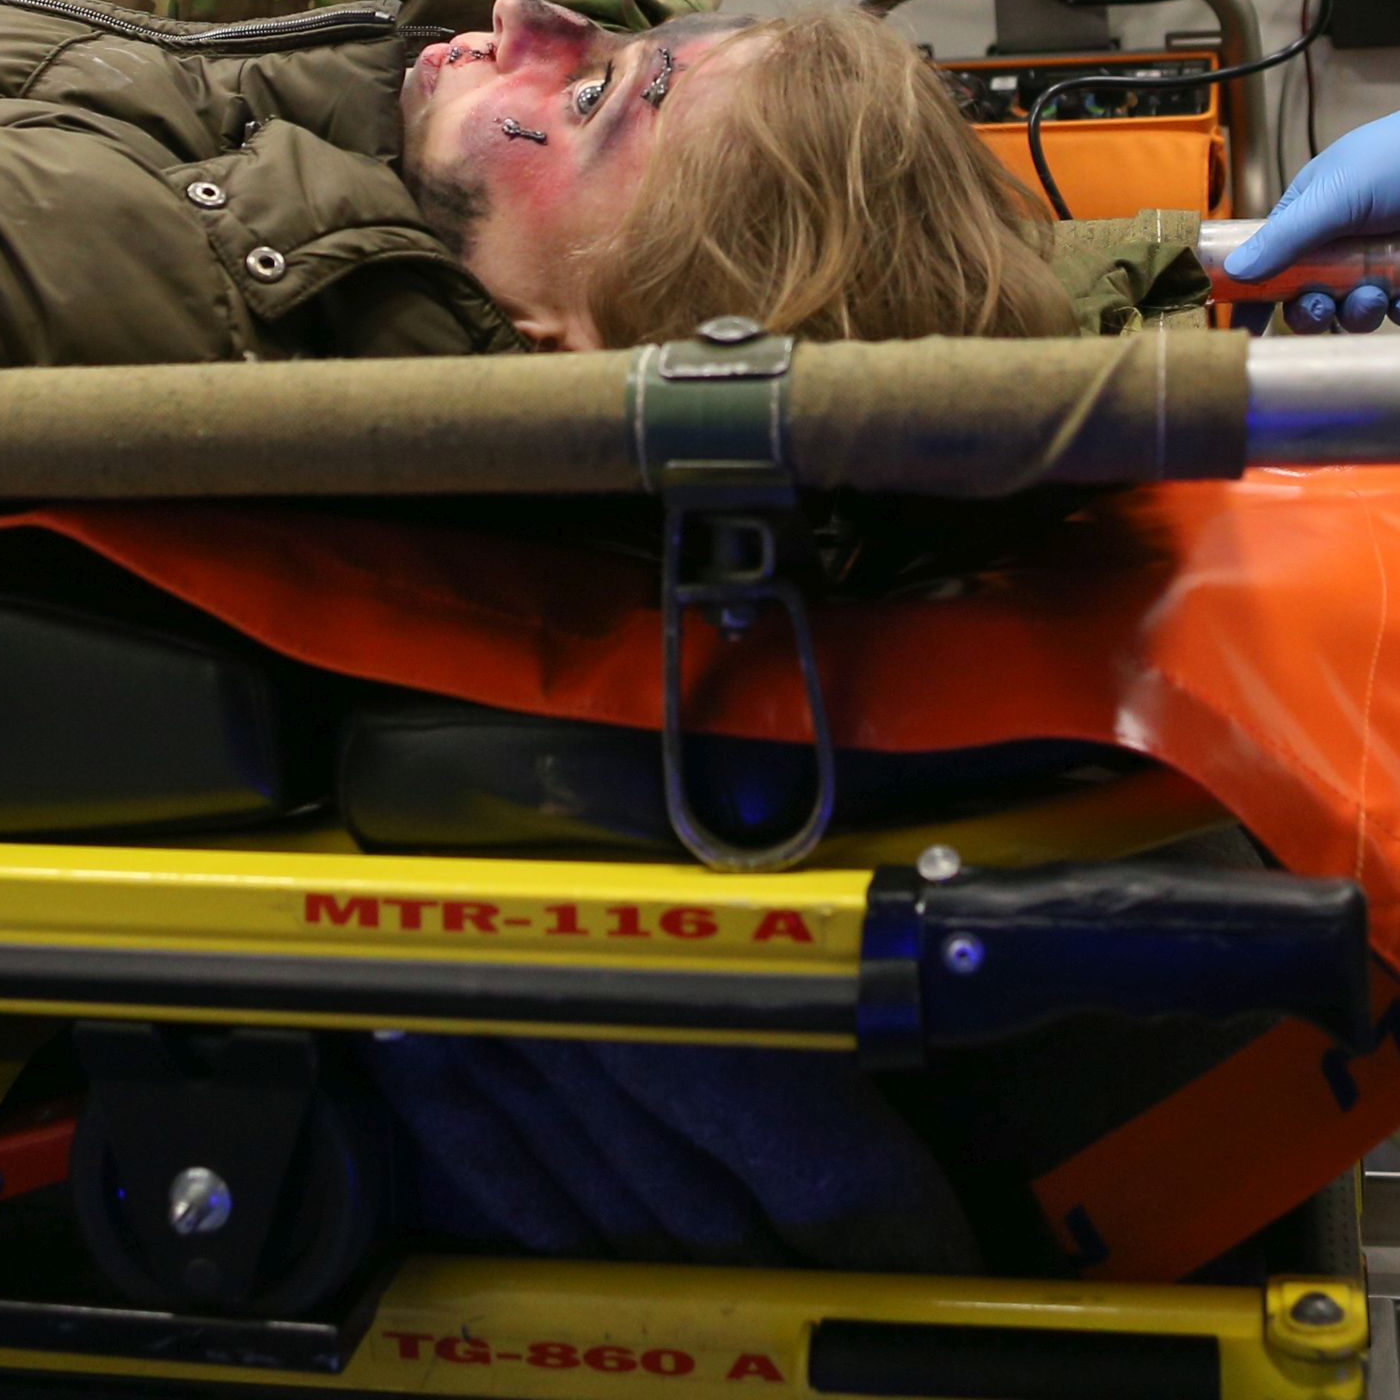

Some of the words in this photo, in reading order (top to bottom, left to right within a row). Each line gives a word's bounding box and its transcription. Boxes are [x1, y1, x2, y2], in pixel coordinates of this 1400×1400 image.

[304, 893, 719, 940] MTR-116
[751, 908, 815, 944] A
[381, 1330, 696, 1377] TG-860
[725, 1352, 786, 1383] A
